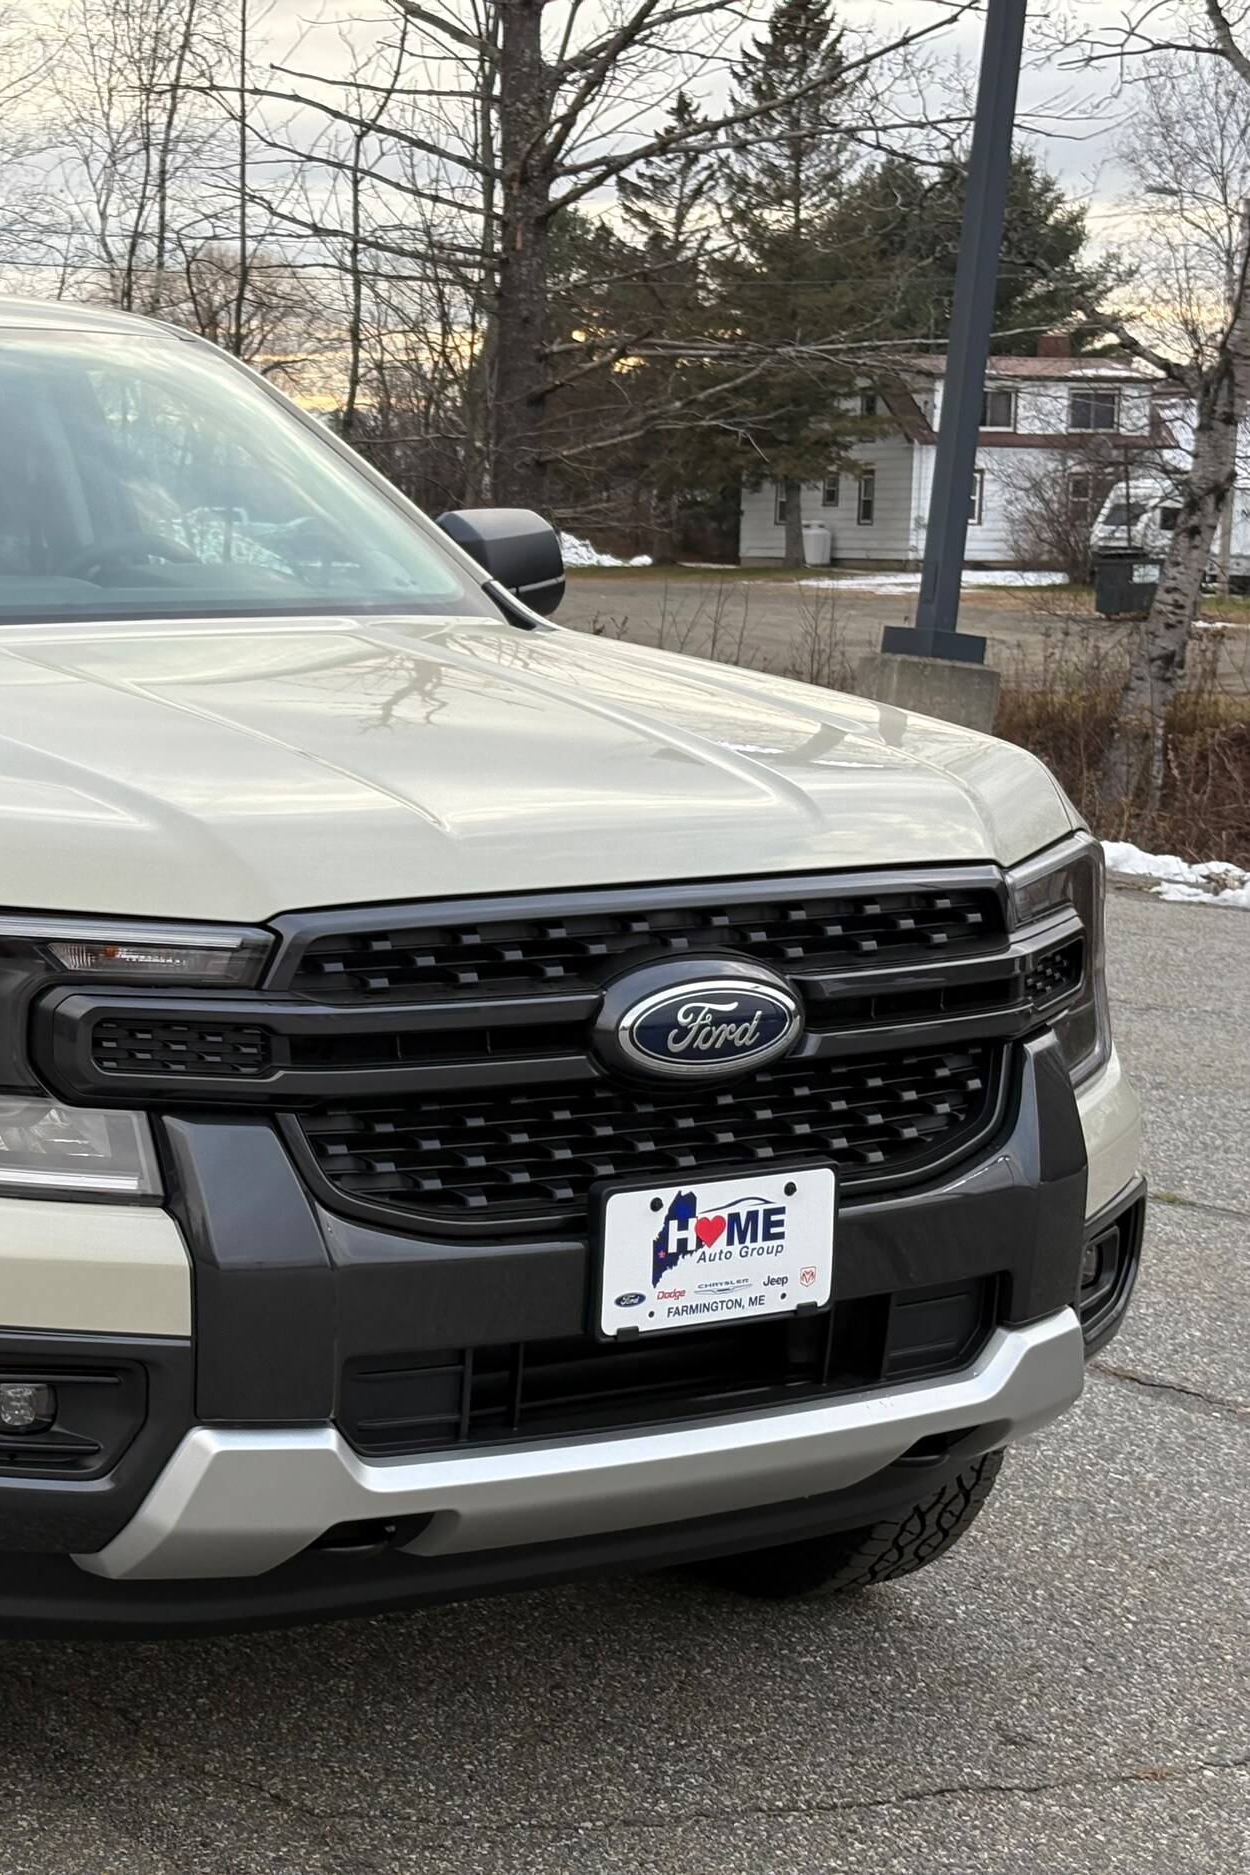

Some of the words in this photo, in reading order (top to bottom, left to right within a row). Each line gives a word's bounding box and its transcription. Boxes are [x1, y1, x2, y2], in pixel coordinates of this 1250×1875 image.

[667, 1001, 763, 1053] Ford
[696, 1247, 733, 1264] Auto
[739, 1243, 785, 1259] Group
[697, 1278, 750, 1289] CHRYSLER
[763, 1275, 789, 1287] Jeep
[656, 1288, 686, 1301] Dodge
[667, 1298, 745, 1318] FARMINGTON,
[748, 1295, 766, 1307] ME
